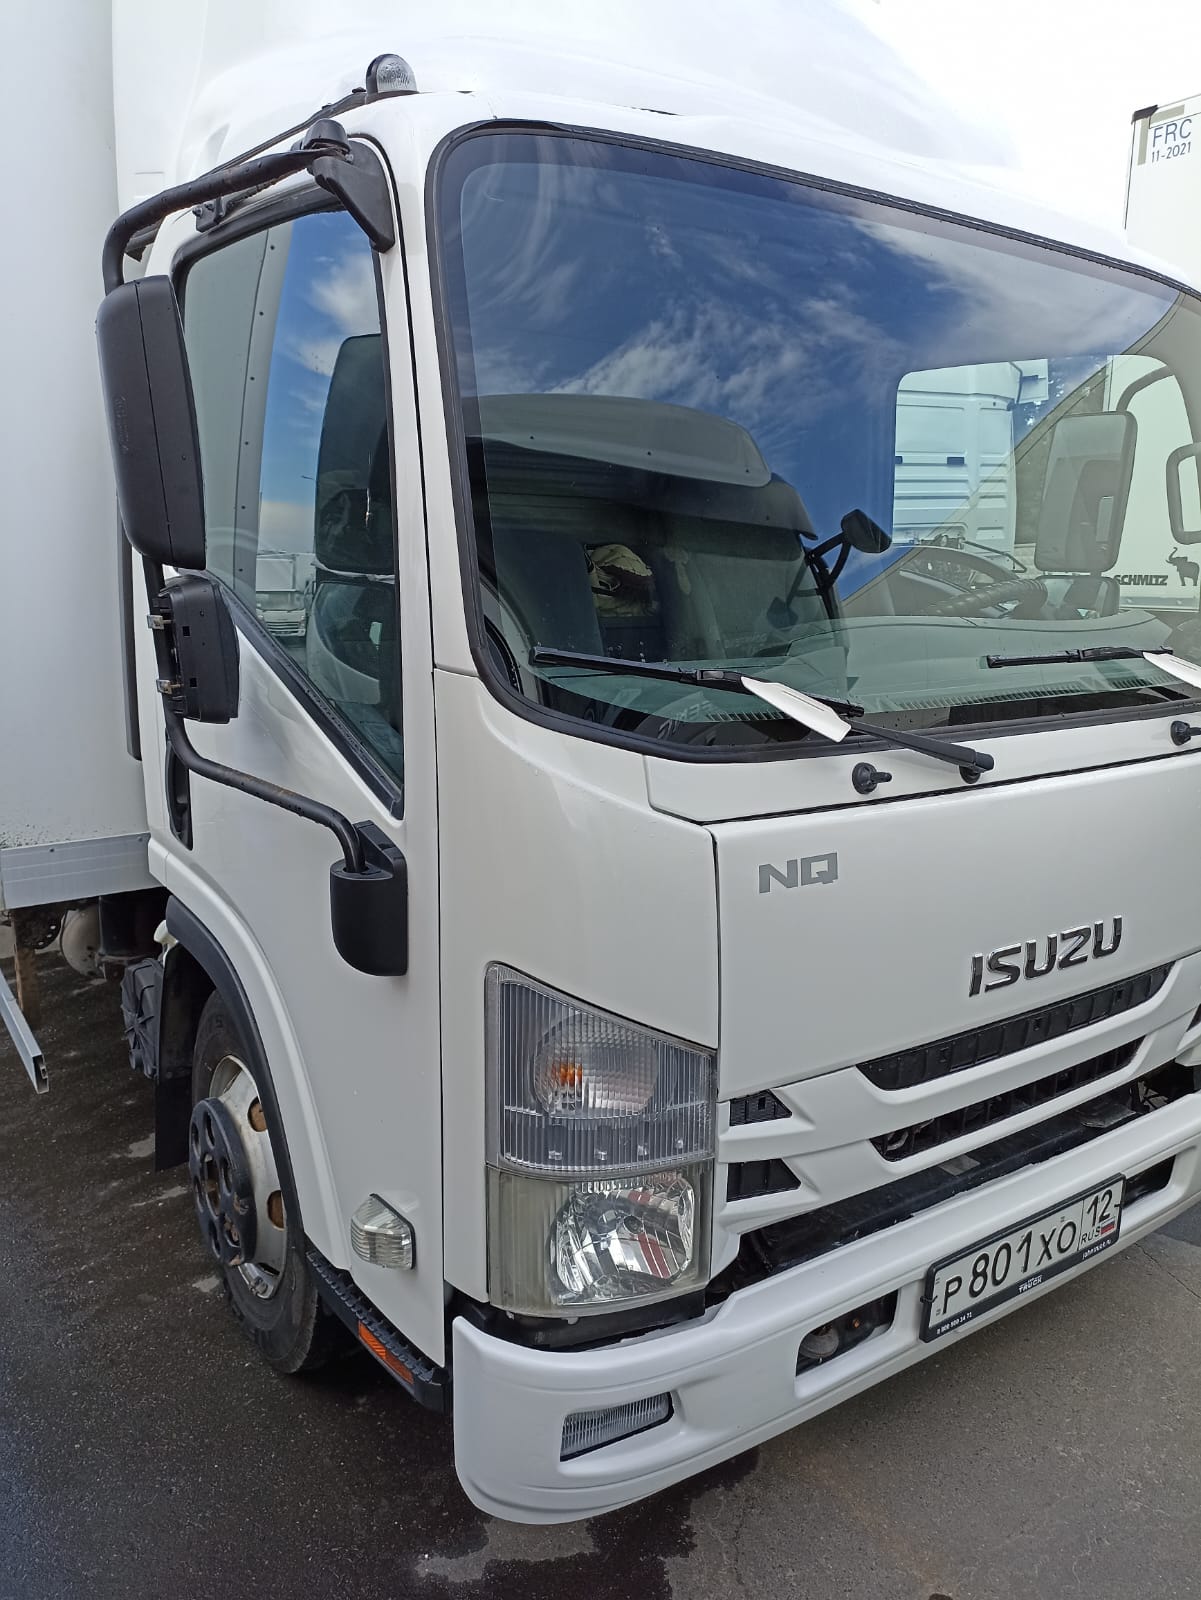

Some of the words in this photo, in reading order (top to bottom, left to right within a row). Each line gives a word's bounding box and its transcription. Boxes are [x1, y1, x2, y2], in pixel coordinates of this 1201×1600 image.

[1152, 118, 1192, 148] FRC
[1151, 141, 1191, 163] 11-2021
[1113, 574, 1169, 586] SCHMITZ
[758, 852, 839, 894] NQ
[968, 915, 1123, 998] ISUZU
[1086, 1188, 1113, 1228] 12
[1080, 1225, 1101, 1245] RUS
